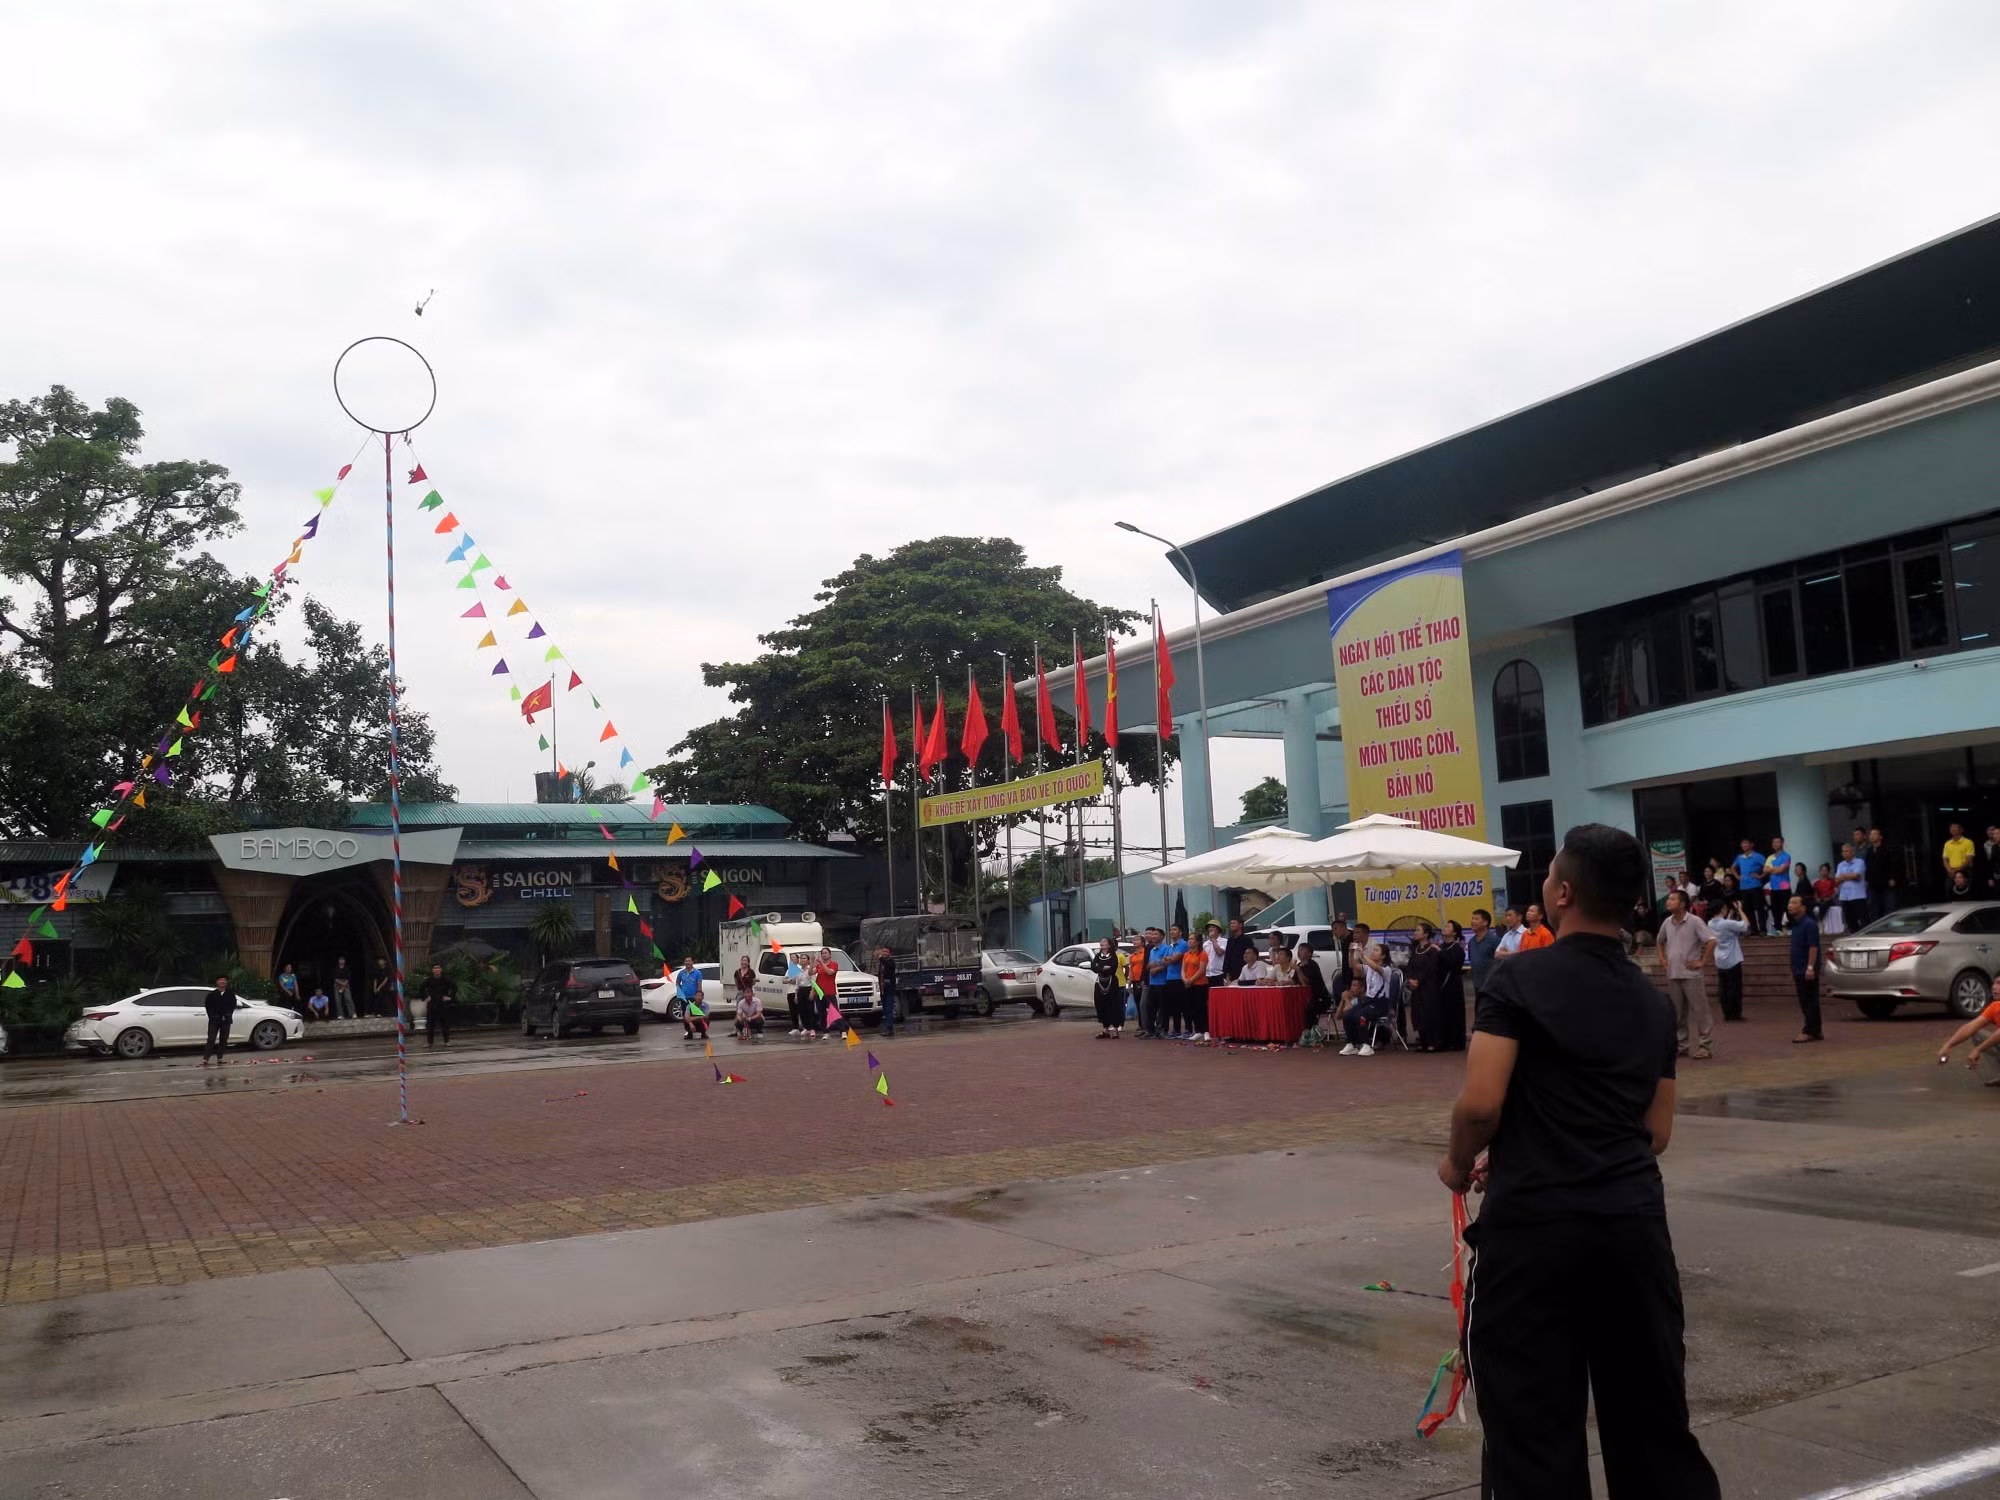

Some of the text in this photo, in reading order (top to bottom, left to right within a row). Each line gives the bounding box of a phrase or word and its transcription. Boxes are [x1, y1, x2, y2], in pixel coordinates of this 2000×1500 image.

[1339, 616, 1460, 667] NGÀY HỘI THỂ THAO
[1360, 656, 1442, 697] CÁC DÂN TỘC
[1375, 689, 1432, 729] THIỂU SỐ
[1359, 727, 1460, 767] MÔN TUNG CÒN,
[1387, 764, 1433, 799] BẮN NỎ
[1420, 801, 1475, 830] NGUYÊN
[240, 837, 359, 859] BAMBOO
[503, 871, 572, 887] SAIGON
[700, 868, 762, 883] SIGON
[520, 888, 572, 898] CHILL
[1364, 887, 1376, 901] Từ
[1378, 886, 1402, 904] ngày
[1405, 884, 1418, 899] 23
